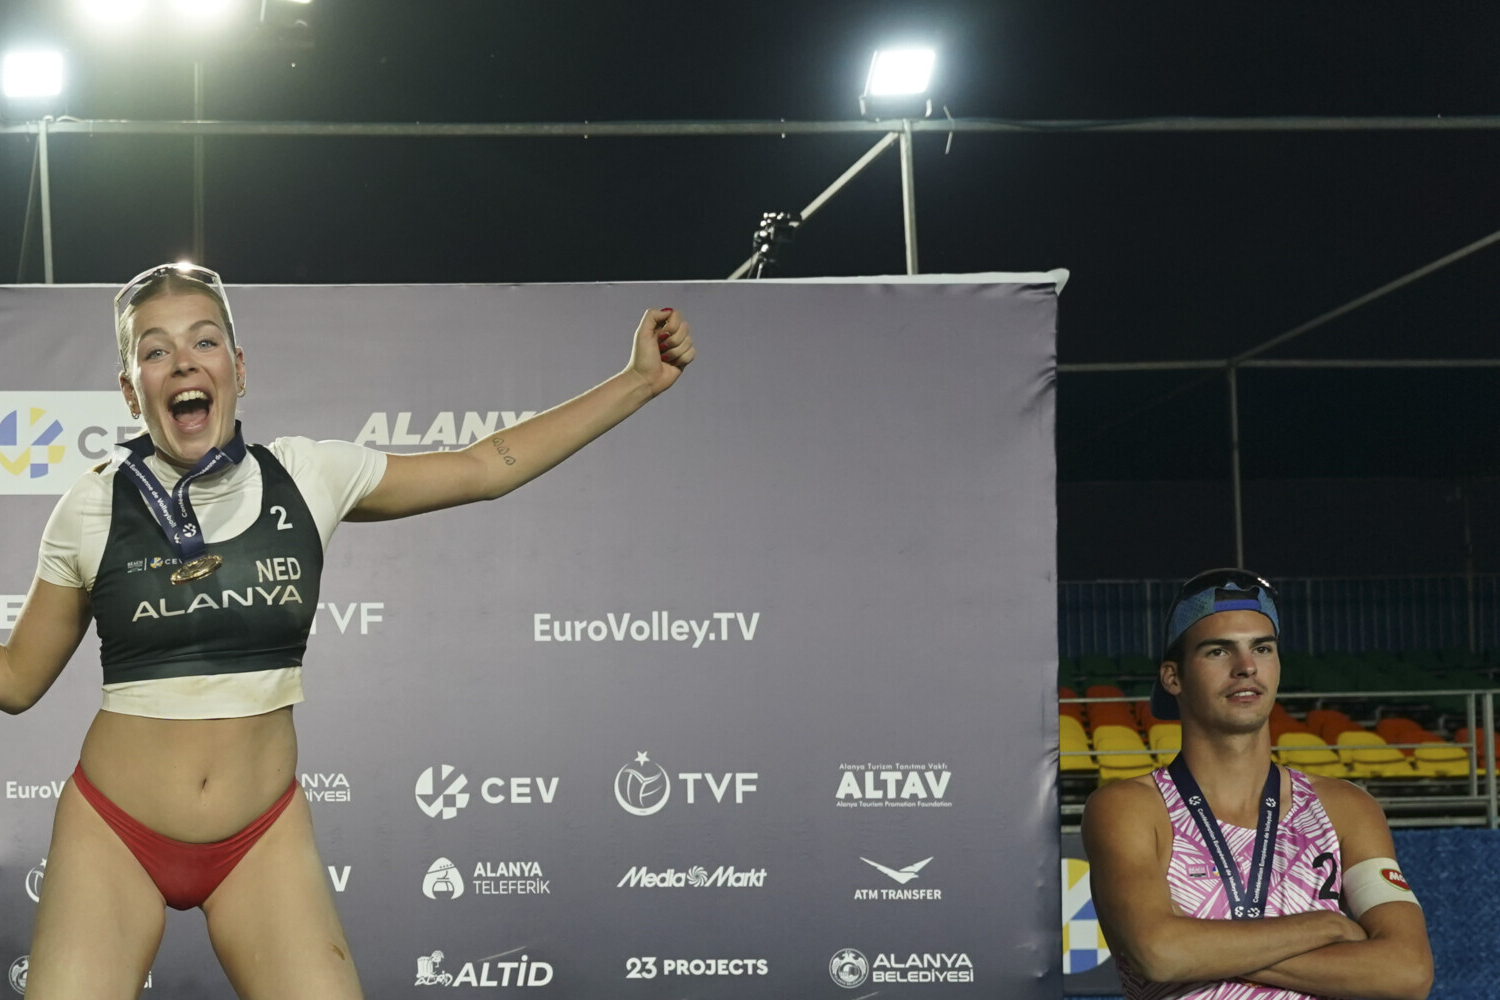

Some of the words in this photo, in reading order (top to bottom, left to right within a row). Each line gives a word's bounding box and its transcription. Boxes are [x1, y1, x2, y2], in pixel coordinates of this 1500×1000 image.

[78, 426, 142, 459] CE
[269, 505, 294, 531] 2
[255, 557, 302, 583] NED
[132, 584, 303, 622] ALANYA
[534, 611, 760, 648] EuroVolley.TV
[839, 763, 865, 771] Alanya
[301, 773, 350, 788] NYA
[481, 777, 559, 804] CEV
[678, 773, 758, 803] TVF
[835, 771, 952, 799] ALTAV
[473, 862, 542, 877] ALANYA
[617, 866, 687, 888] Media
[704, 866, 767, 887] Markt
[1312, 852, 1340, 900] 2
[473, 878, 550, 894] TELEFERİK
[854, 889, 878, 900] ATM
[881, 889, 942, 900] TRANSFER
[452, 955, 554, 986] ALTİD
[626, 957, 657, 979] 23
[663, 959, 769, 975] PROJECTS
[873, 953, 973, 968] ALANYA
[872, 969, 974, 982] BELEDİYESİ
